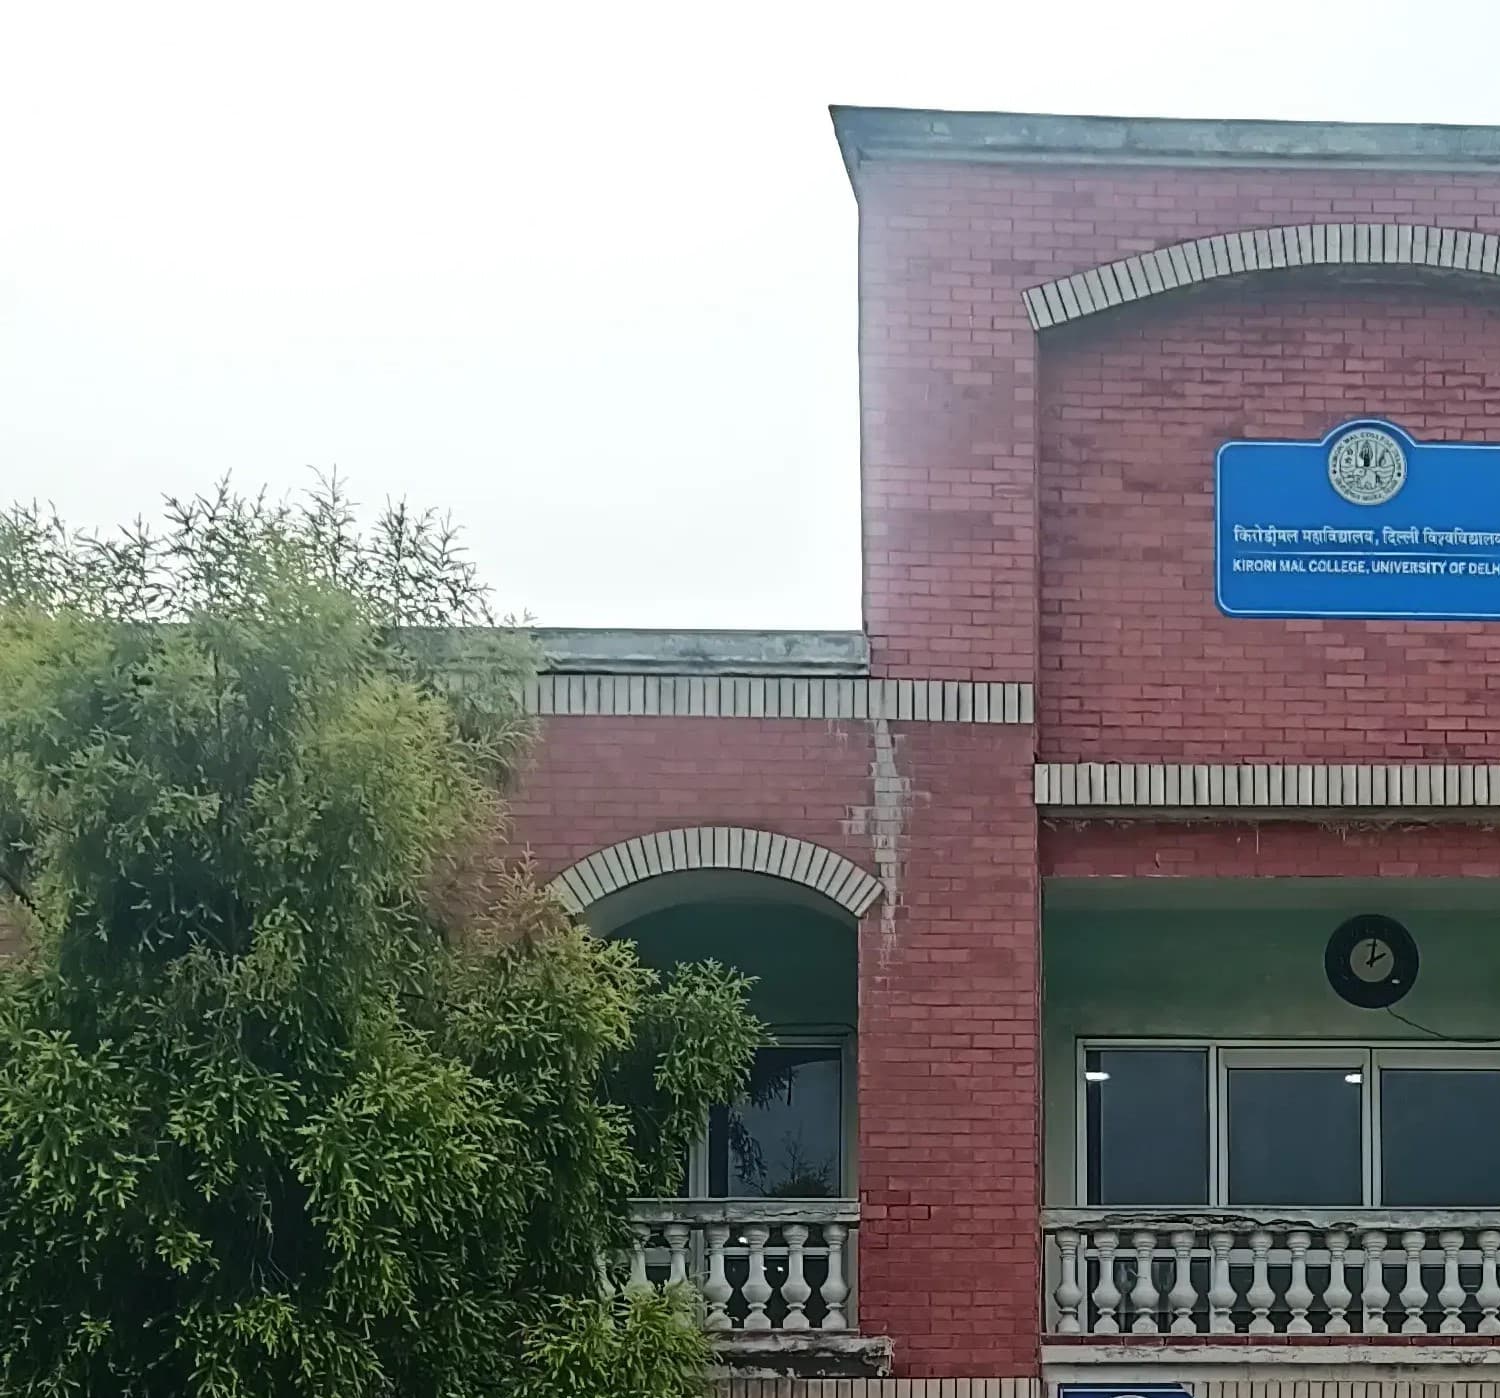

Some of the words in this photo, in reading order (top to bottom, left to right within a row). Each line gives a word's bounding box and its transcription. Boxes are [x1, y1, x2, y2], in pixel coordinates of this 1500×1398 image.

[1383, 526, 1419, 546] दिल्ली
[1232, 559, 1276, 572] KIRORI
[1280, 559, 1306, 573] MAL
[1309, 560, 1370, 575] COLLEGE,
[1372, 560, 1447, 575] UNIVERSITY
[1449, 561, 1466, 575] OF
